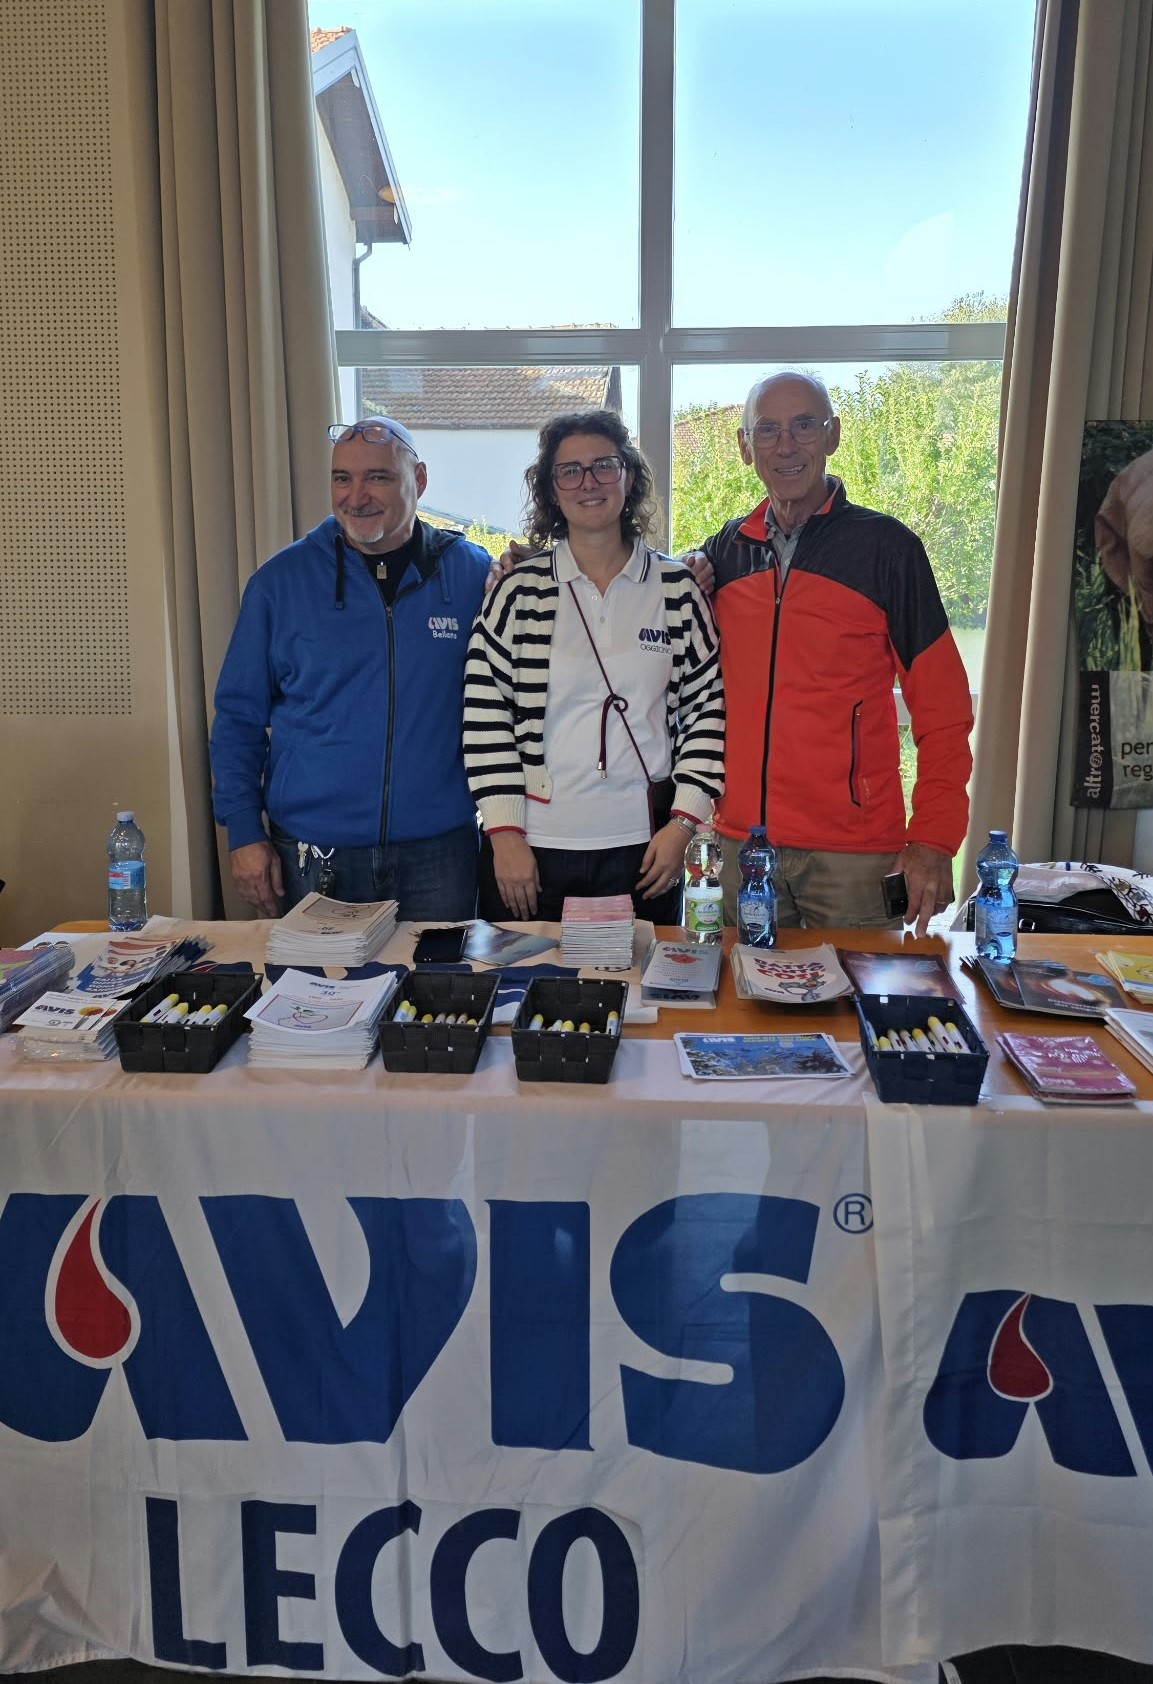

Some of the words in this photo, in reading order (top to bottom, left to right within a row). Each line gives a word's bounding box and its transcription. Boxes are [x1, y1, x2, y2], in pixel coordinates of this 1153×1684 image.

[428, 616, 459, 631] AVIS
[639, 627, 672, 646] AVIS
[34, 1004, 76, 1015] AVIS
[0, 1192, 846, 1475] AVIS
[145, 1496, 641, 1684] LECCO
